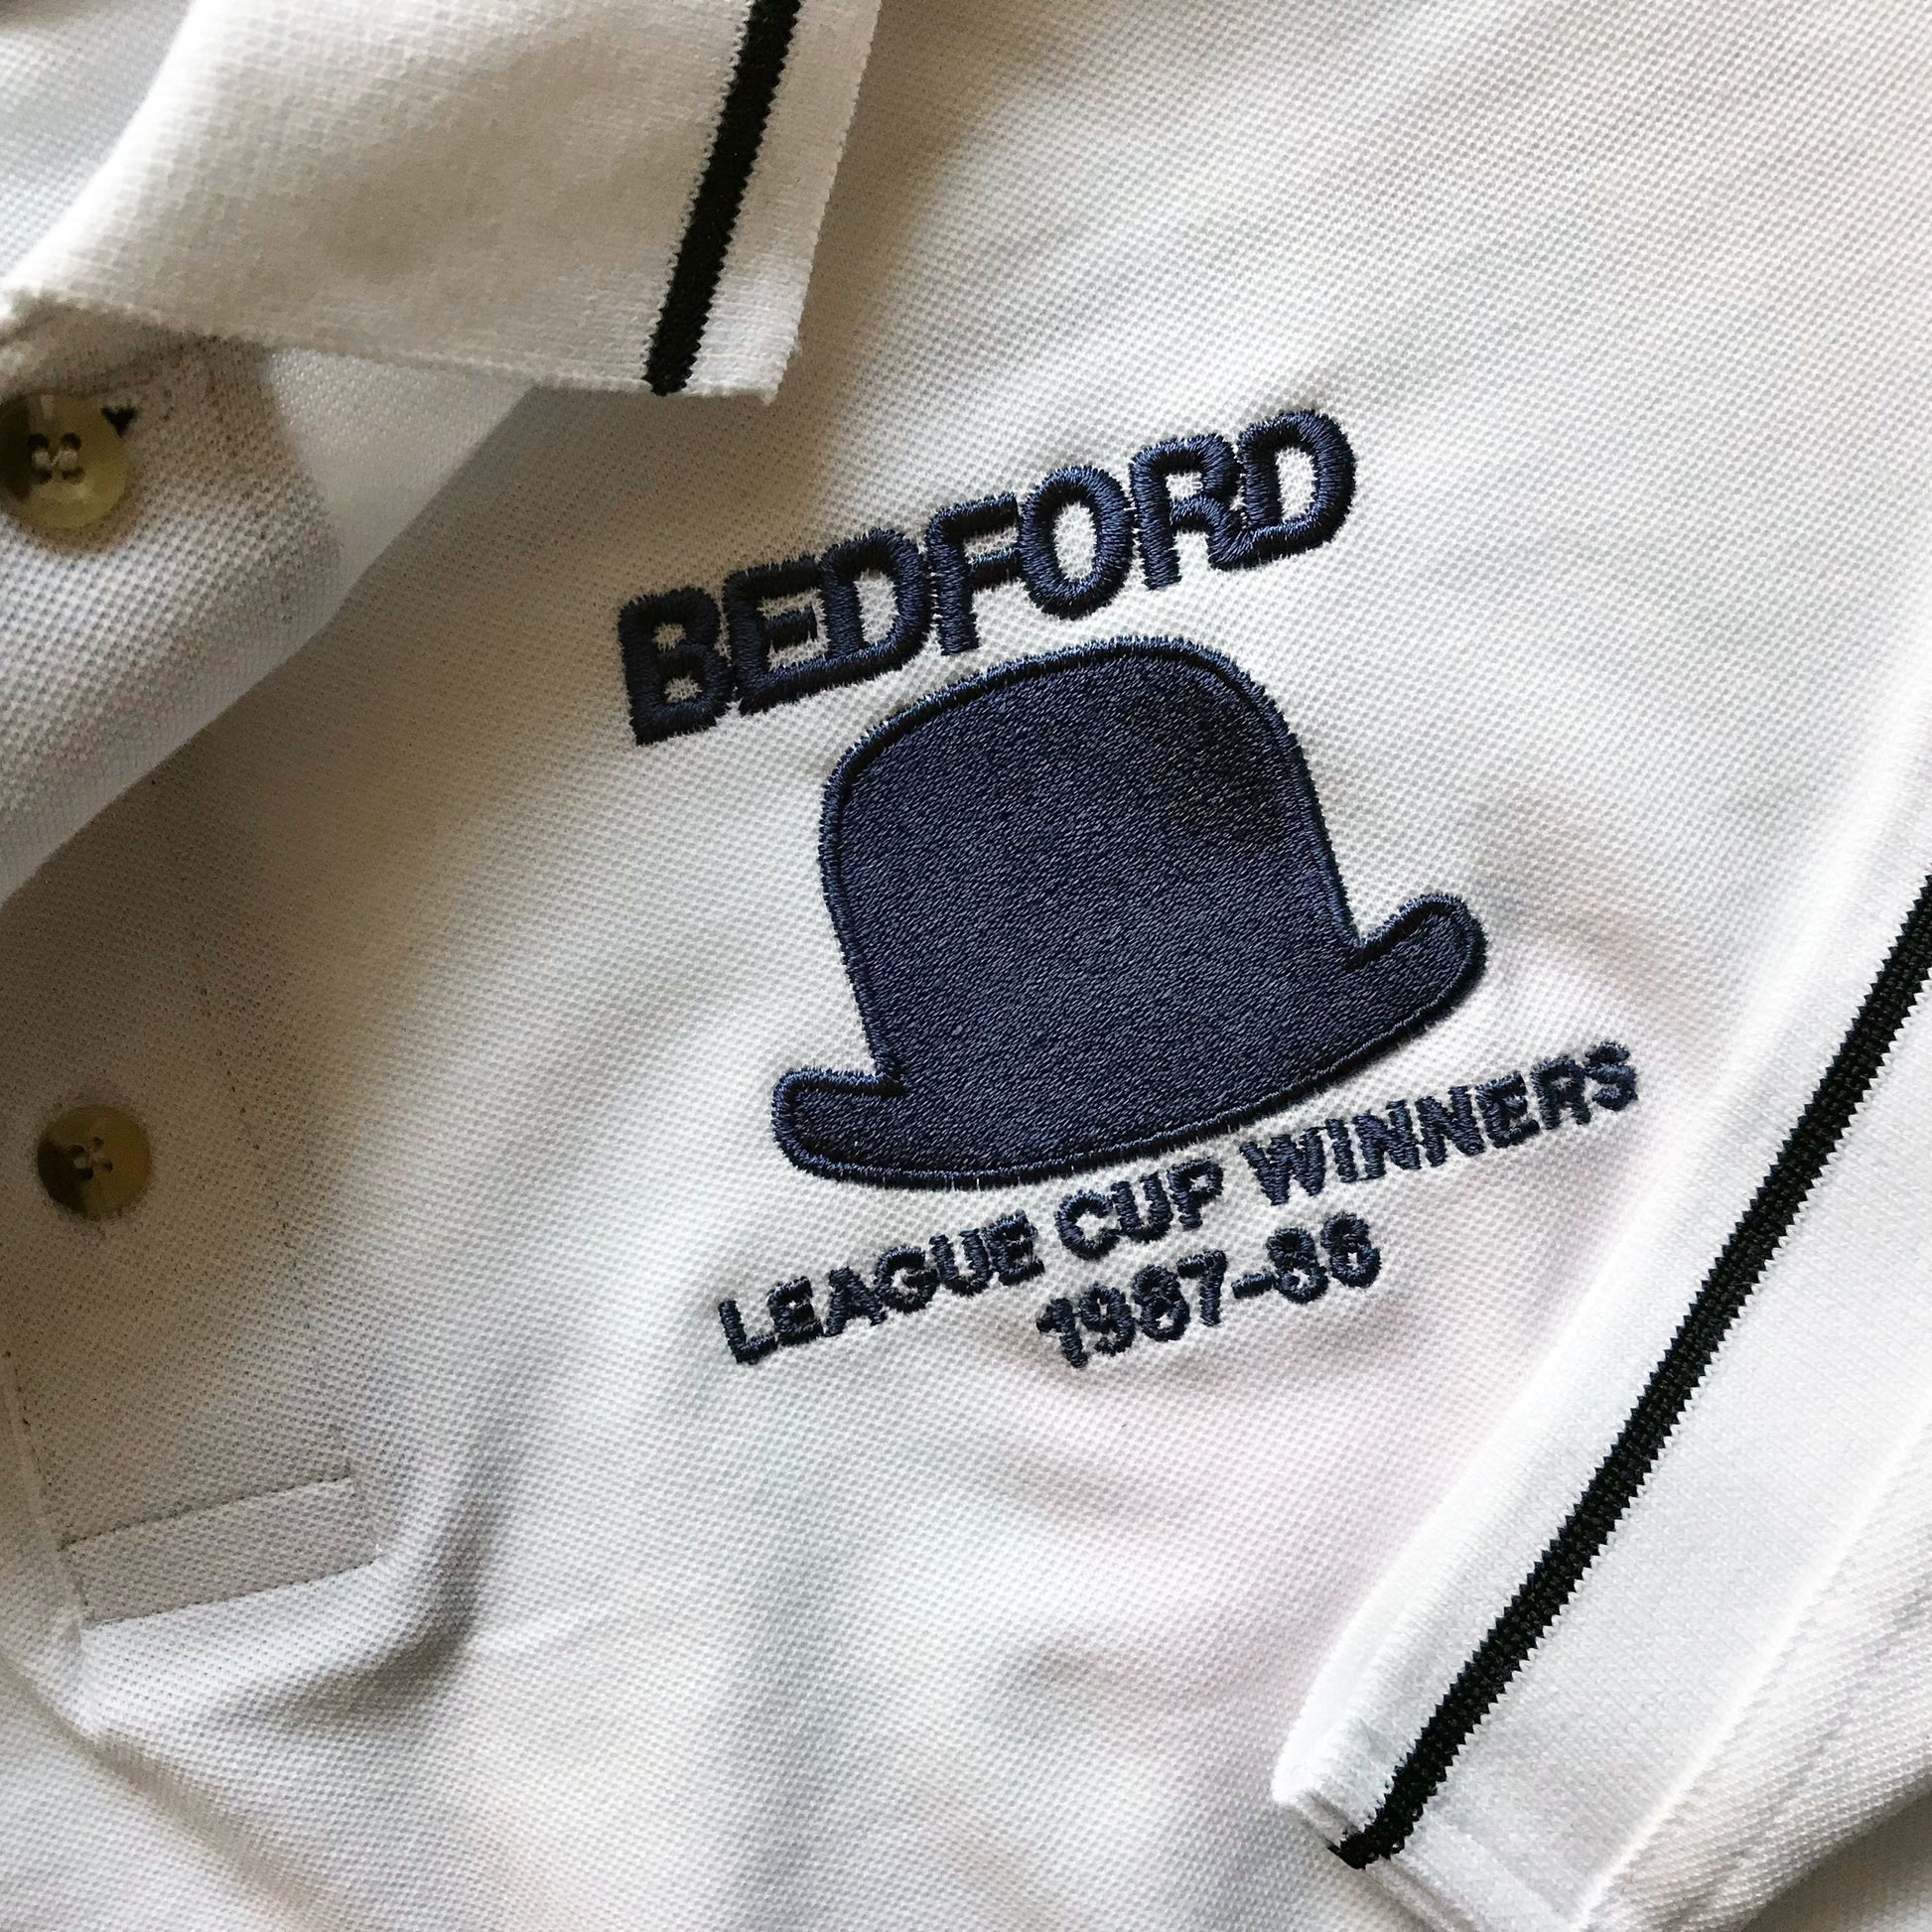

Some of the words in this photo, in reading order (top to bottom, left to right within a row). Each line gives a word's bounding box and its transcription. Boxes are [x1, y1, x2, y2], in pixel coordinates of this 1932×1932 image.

[618, 408, 1356, 747] BEDFORD
[717, 1210, 1045, 1365] LEAGUE
[1054, 1159, 1225, 1261] CUP
[1238, 1040, 1638, 1206] WINNERS
[1035, 1210, 1383, 1369] 1987-88
